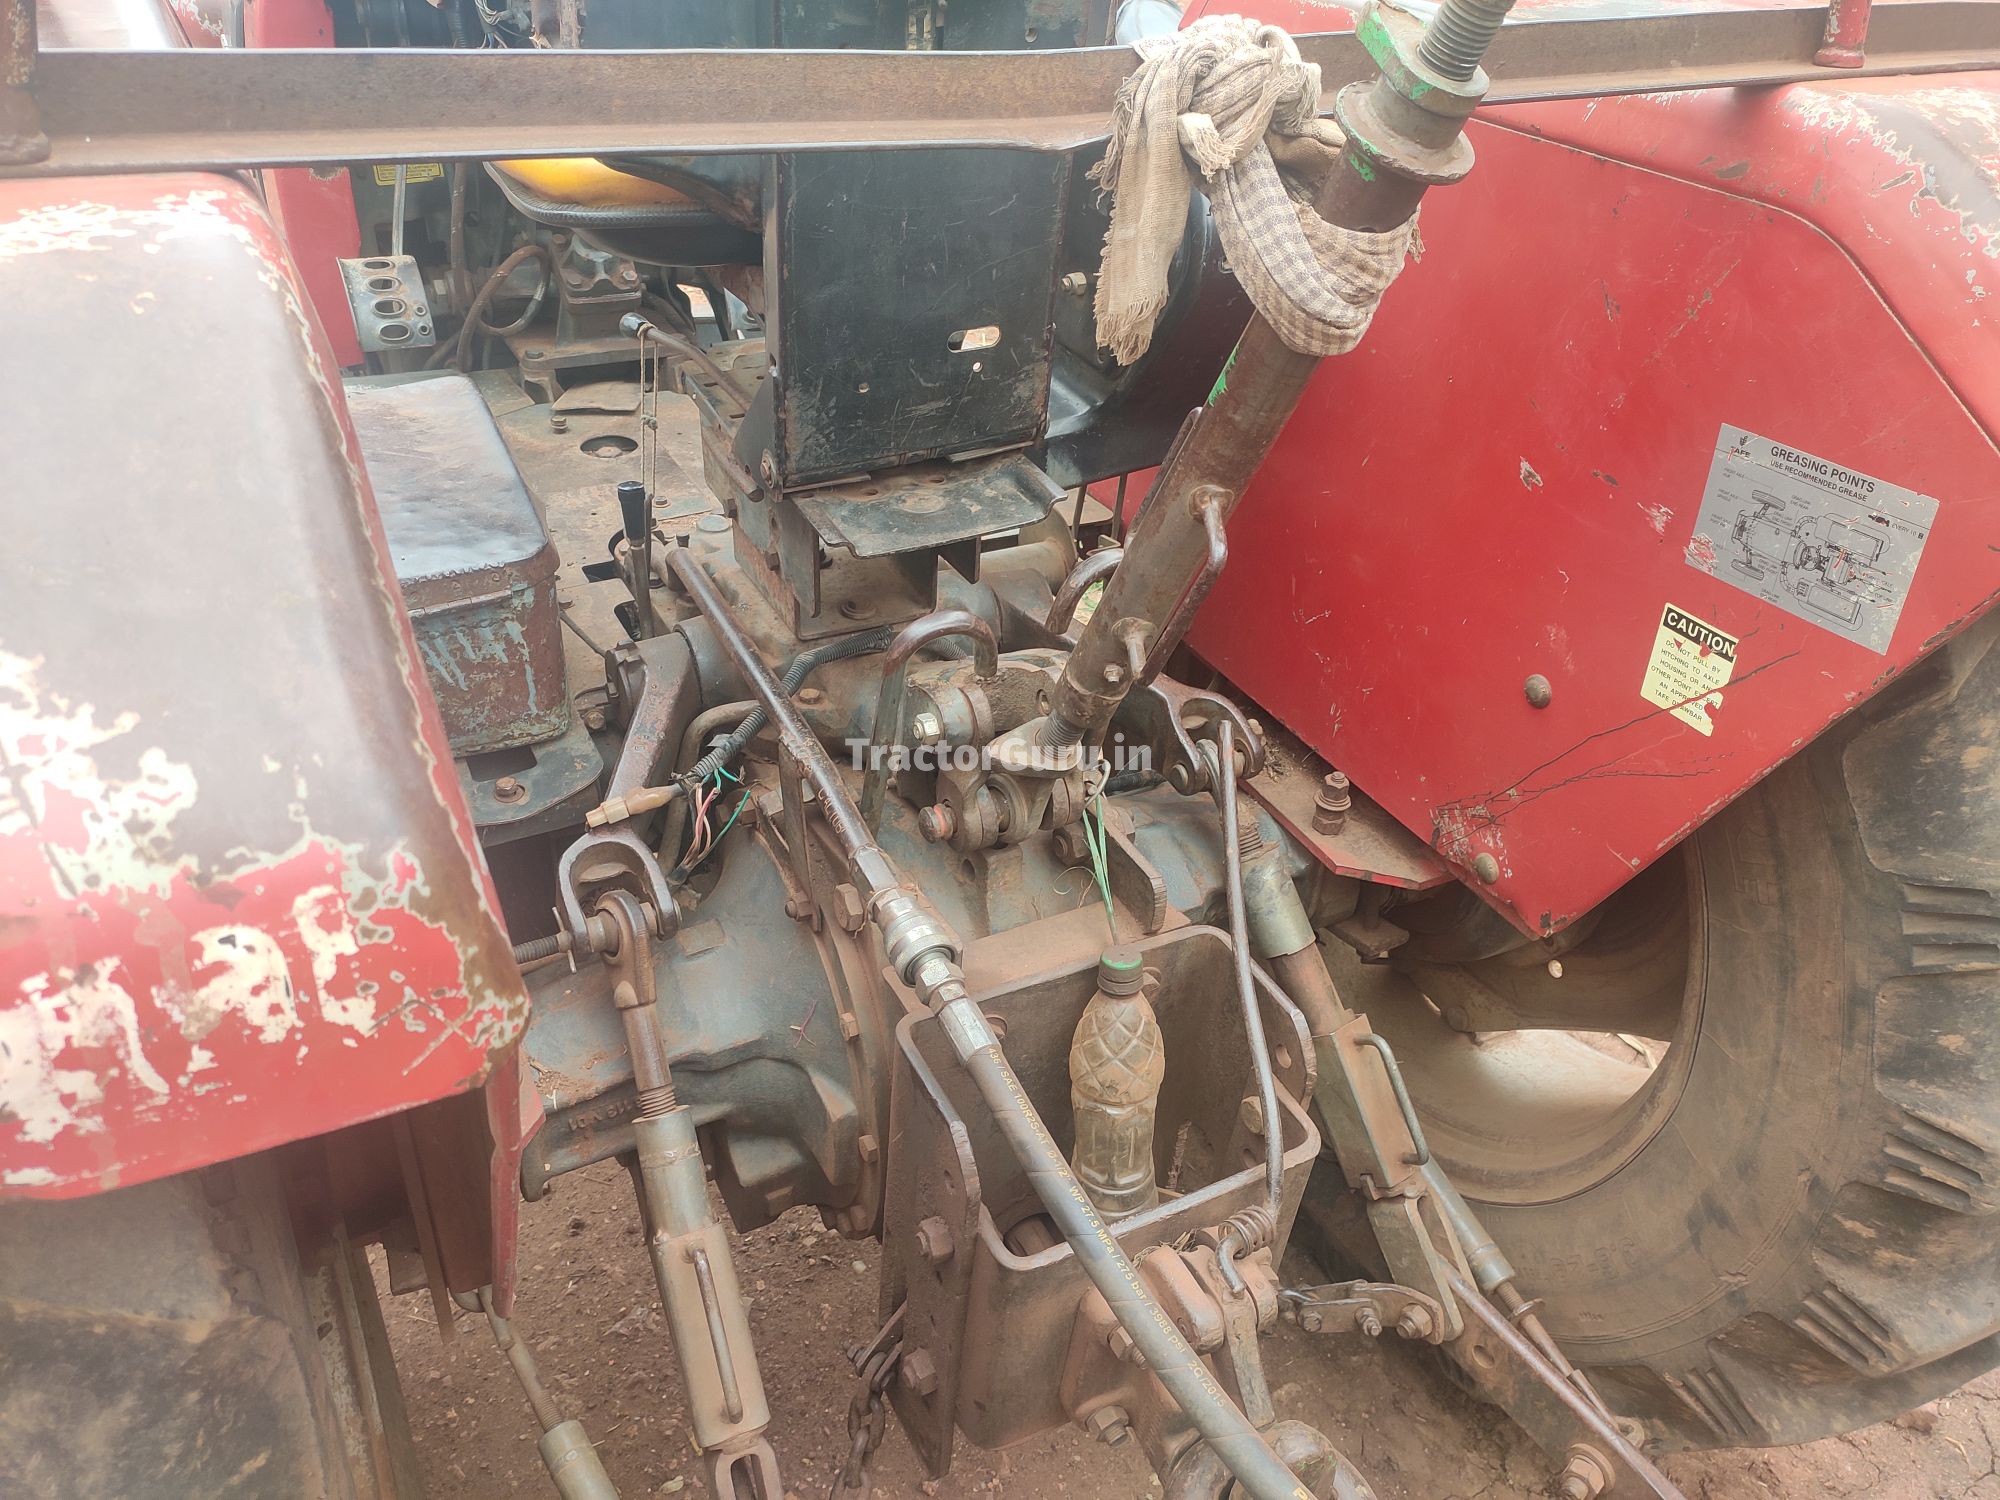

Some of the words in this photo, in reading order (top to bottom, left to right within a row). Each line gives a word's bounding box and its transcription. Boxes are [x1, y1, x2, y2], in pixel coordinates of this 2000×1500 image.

[1770, 459, 1783, 470] USE
[1785, 464, 1838, 490] RECOMMENDED
[1838, 486, 1868, 502] GREASE
[1771, 446, 1828, 475] GREASING
[1831, 468, 1875, 493] POINTS
[1667, 612, 1735, 657] CAUTION
[1660, 659, 1687, 679] HOUSING
[1690, 676, 1699, 686] OR
[1661, 648, 1689, 669] HITCHING
[1692, 665, 1701, 675] TO
[1703, 672, 1720, 686] AXLE
[1666, 639, 1675, 649] DO
[1678, 646, 1691, 657] NOT
[1693, 655, 1708, 668] PULL
[1711, 665, 1721, 674] BY
[1651, 665, 1671, 680] OTHER
[1673, 678, 1692, 693] POINT
[1655, 689, 1670, 702] TAFE
[1659, 681, 1668, 690] AN
[1000, 1071, 1018, 1092] SAE
[1069, 1185, 1085, 1204] WP
[1081, 1205, 1099, 1228] 27.5
[1095, 1229, 1116, 1254] MPa
[1116, 1260, 1134, 1281] 275
[1131, 1281, 1148, 1300] bar
[1150, 1308, 1172, 1336] 3988
